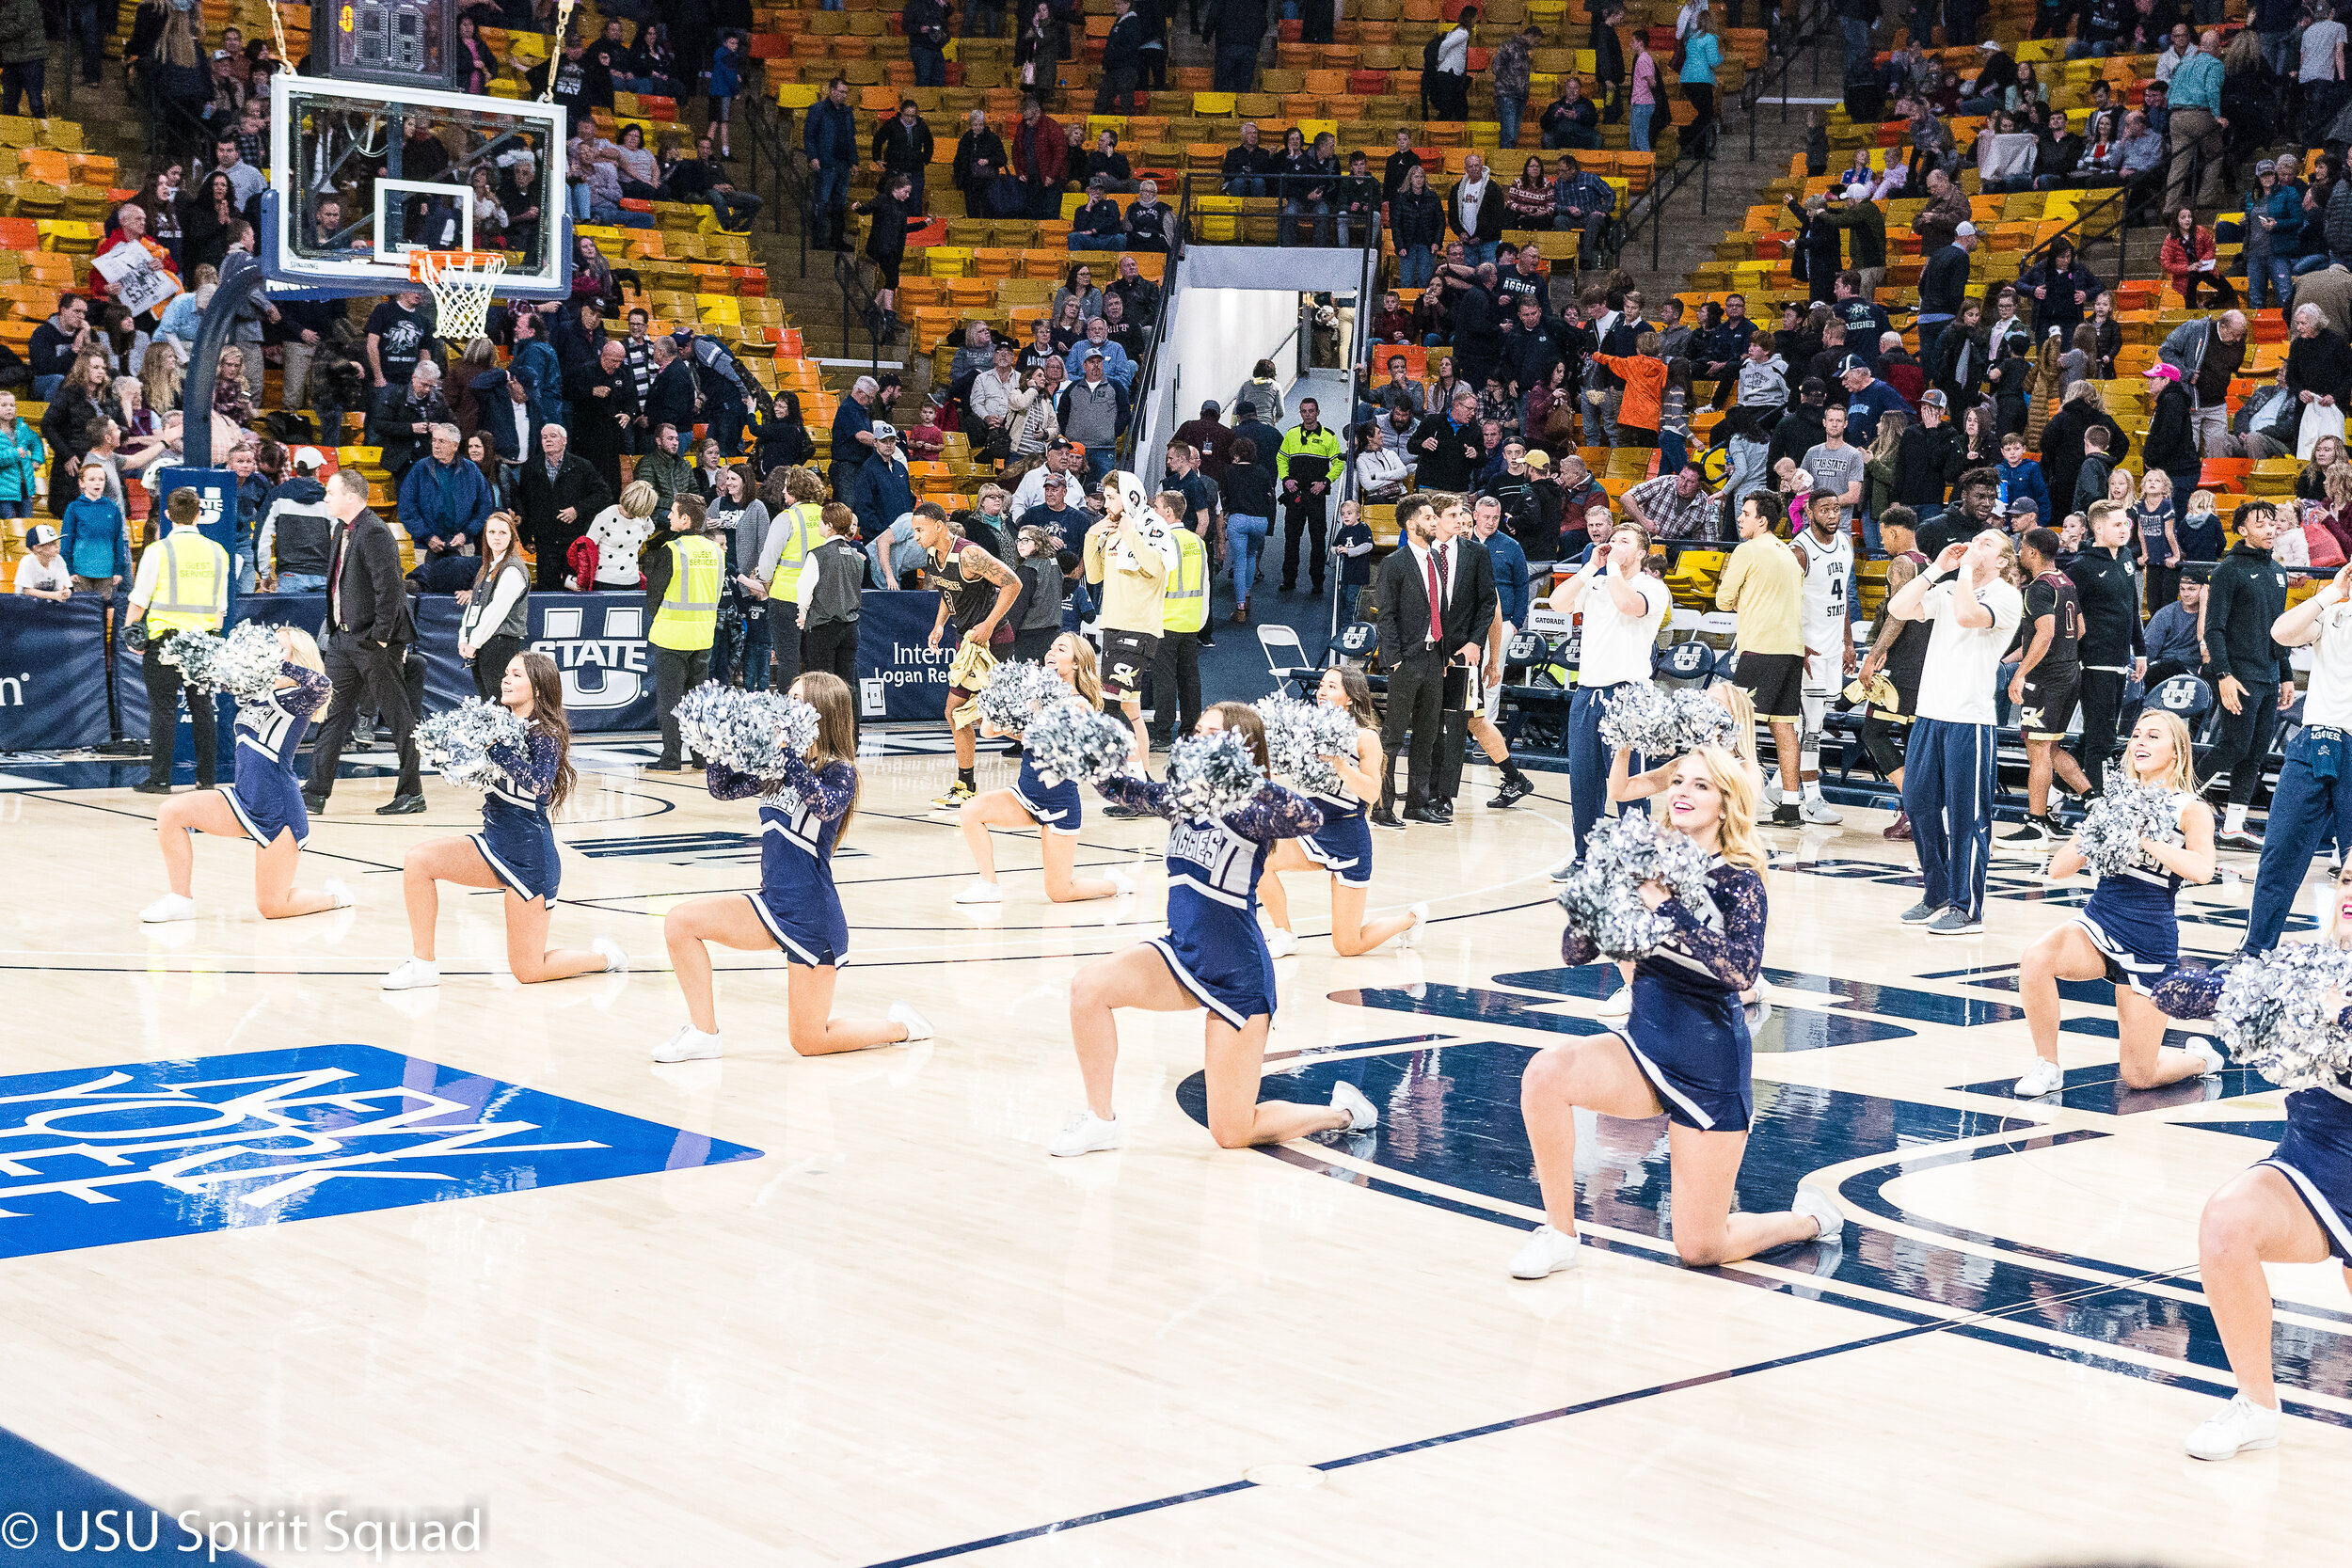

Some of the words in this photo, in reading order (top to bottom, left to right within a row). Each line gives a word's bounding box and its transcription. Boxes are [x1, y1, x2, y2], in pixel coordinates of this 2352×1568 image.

[290, 261, 319, 270] SPALDING
[1503, 279, 1536, 294] AGGIES
[1846, 321, 1876, 330] AGGIES
[1812, 458, 1826, 469] UTAH
[1827, 458, 1848, 471] STATE
[693, 550, 712, 559] GUEST
[185, 562, 211, 570] GUEST
[1826, 562, 1844, 577] UTAH
[179, 569, 215, 578] SERVICES
[1831, 578, 1843, 600] 4
[1534, 616, 1565, 626] GATORADE
[2065, 600, 2075, 639] 0
[530, 640, 648, 673] STATE
[1168, 824, 1223, 869] AGGIES
